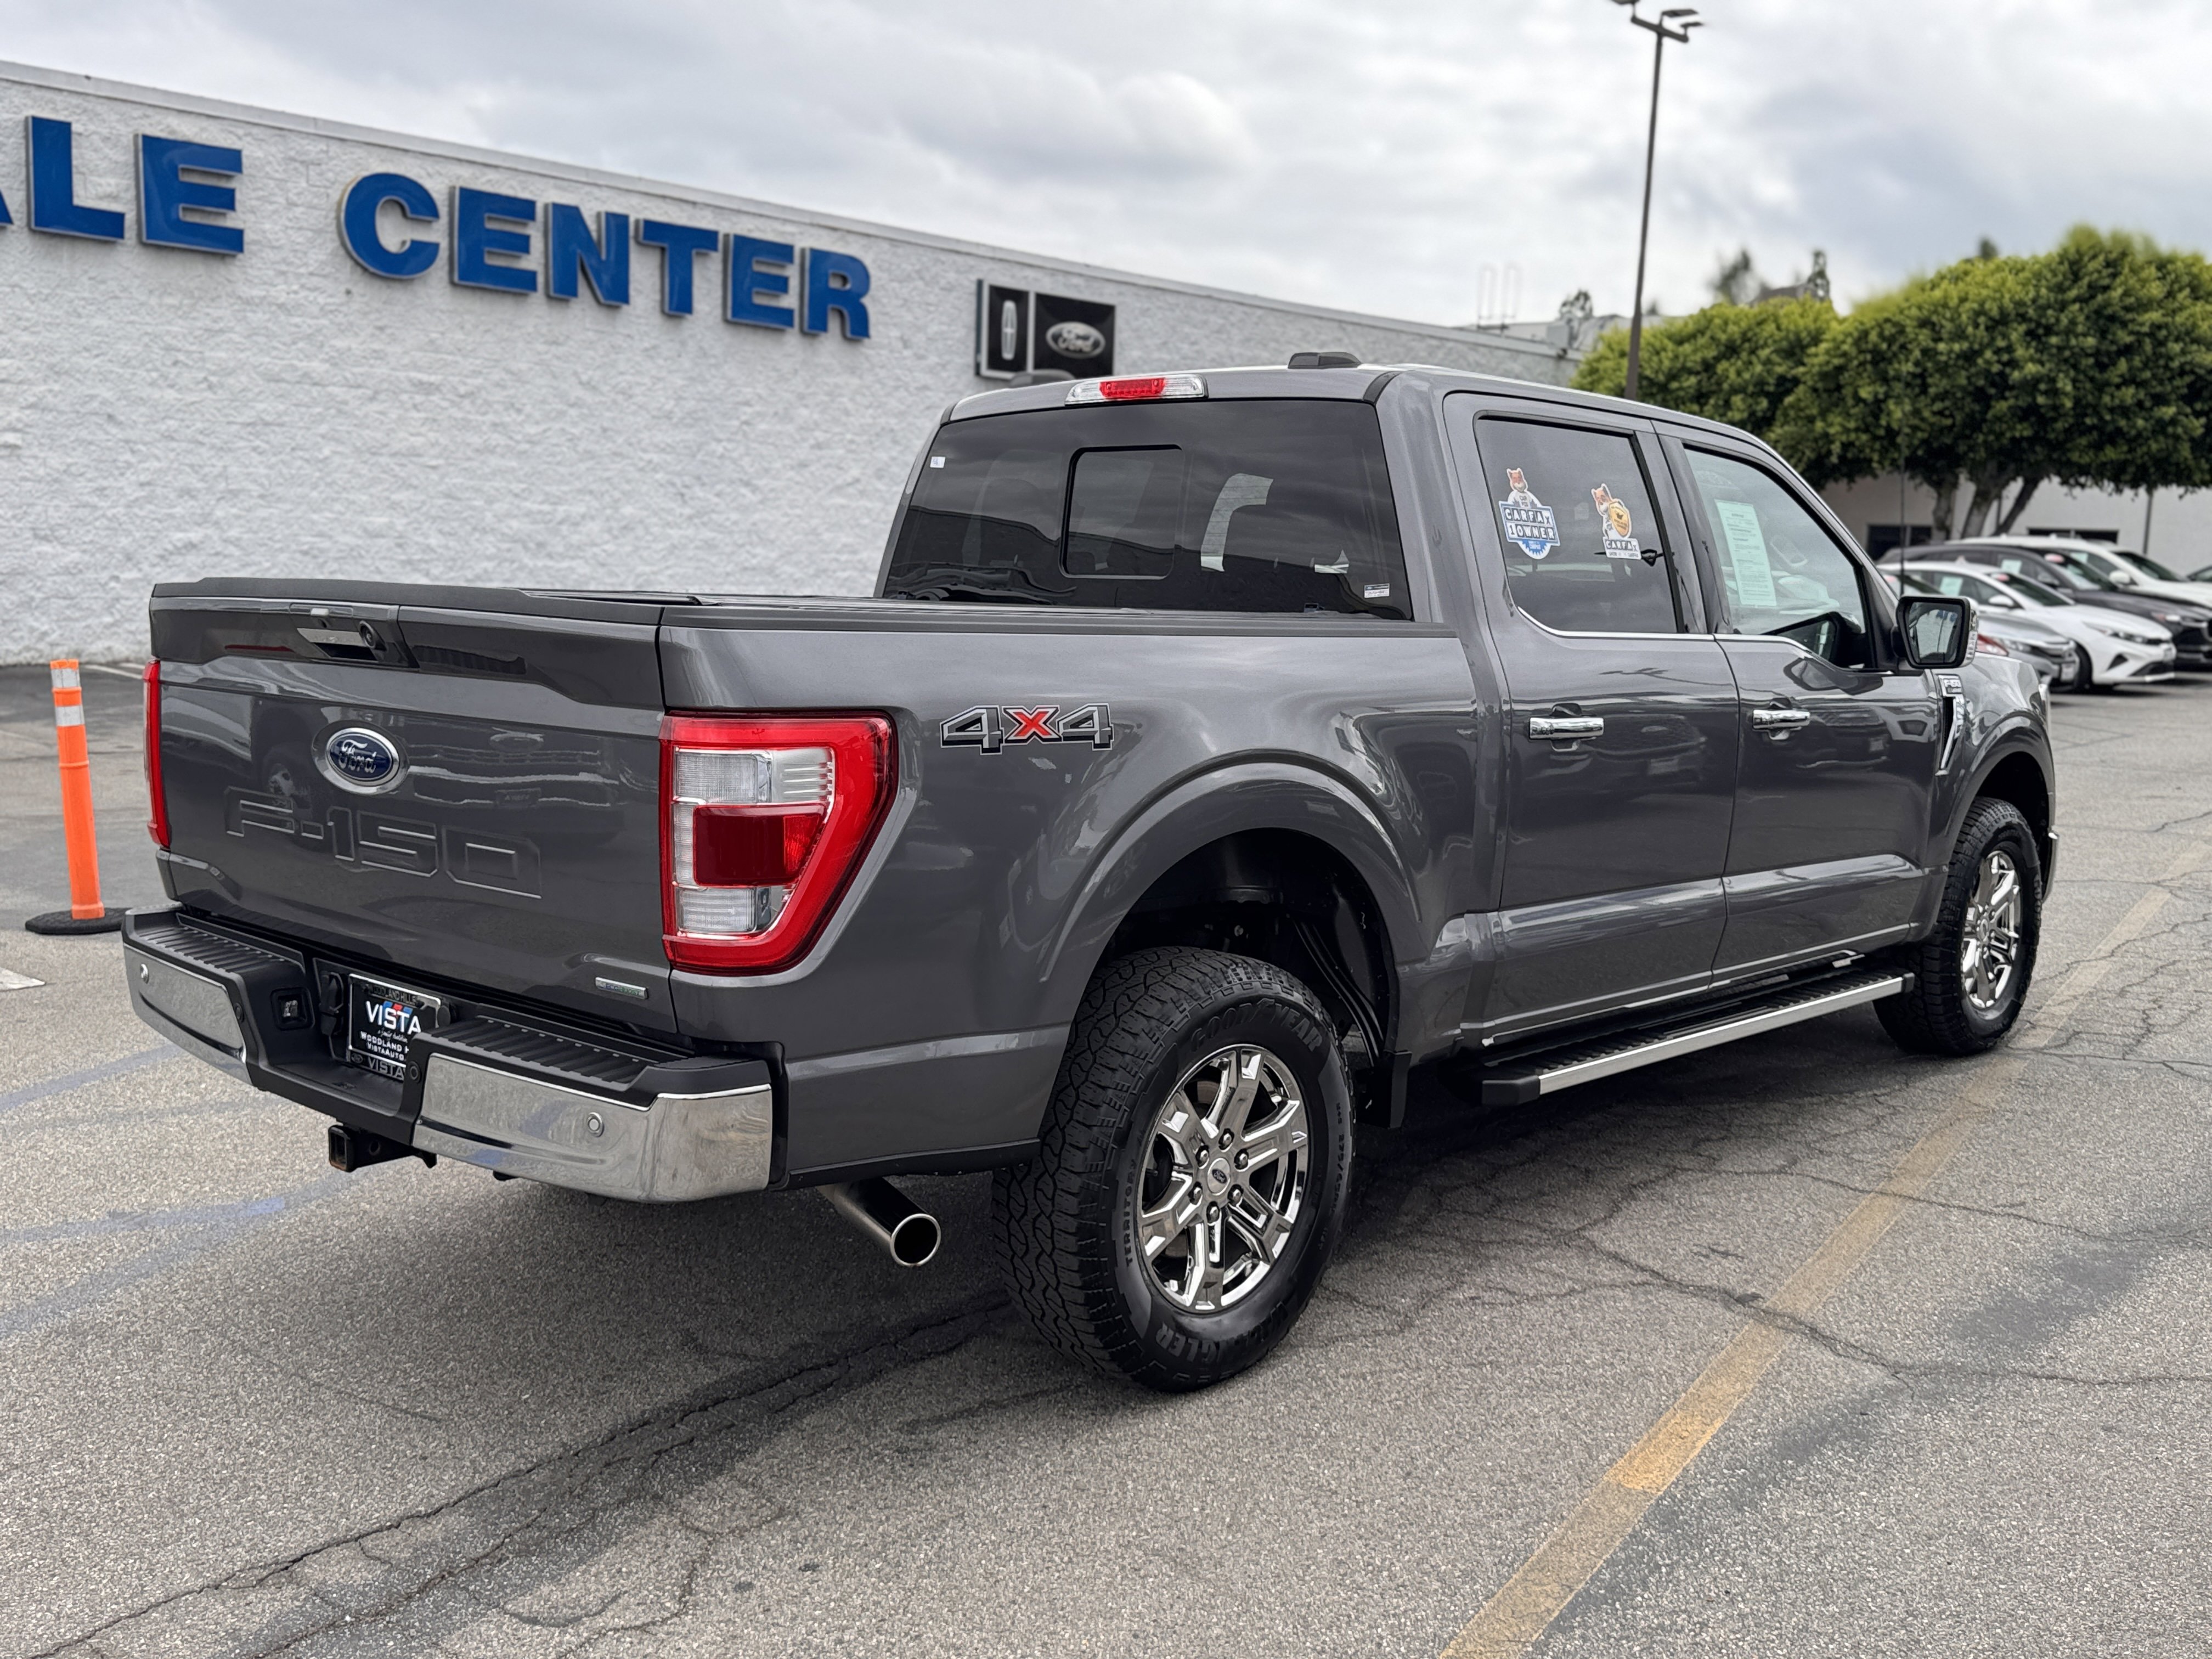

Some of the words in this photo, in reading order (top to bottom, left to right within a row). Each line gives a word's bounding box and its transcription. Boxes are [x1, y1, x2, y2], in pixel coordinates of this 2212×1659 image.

[0, 115, 245, 255] LE
[337, 172, 871, 340] CENTER
[1504, 508, 1551, 525] CARFAX
[1605, 539, 1638, 552] CARFAX
[338, 739, 377, 774] Ford
[223, 786, 542, 899] F-150
[365, 1000, 422, 1035] VISTA
[360, 1030, 402, 1051] WOODLAND
[368, 1057, 405, 1080] VISTA
[1124, 1158, 1137, 1267] TERRITORY
